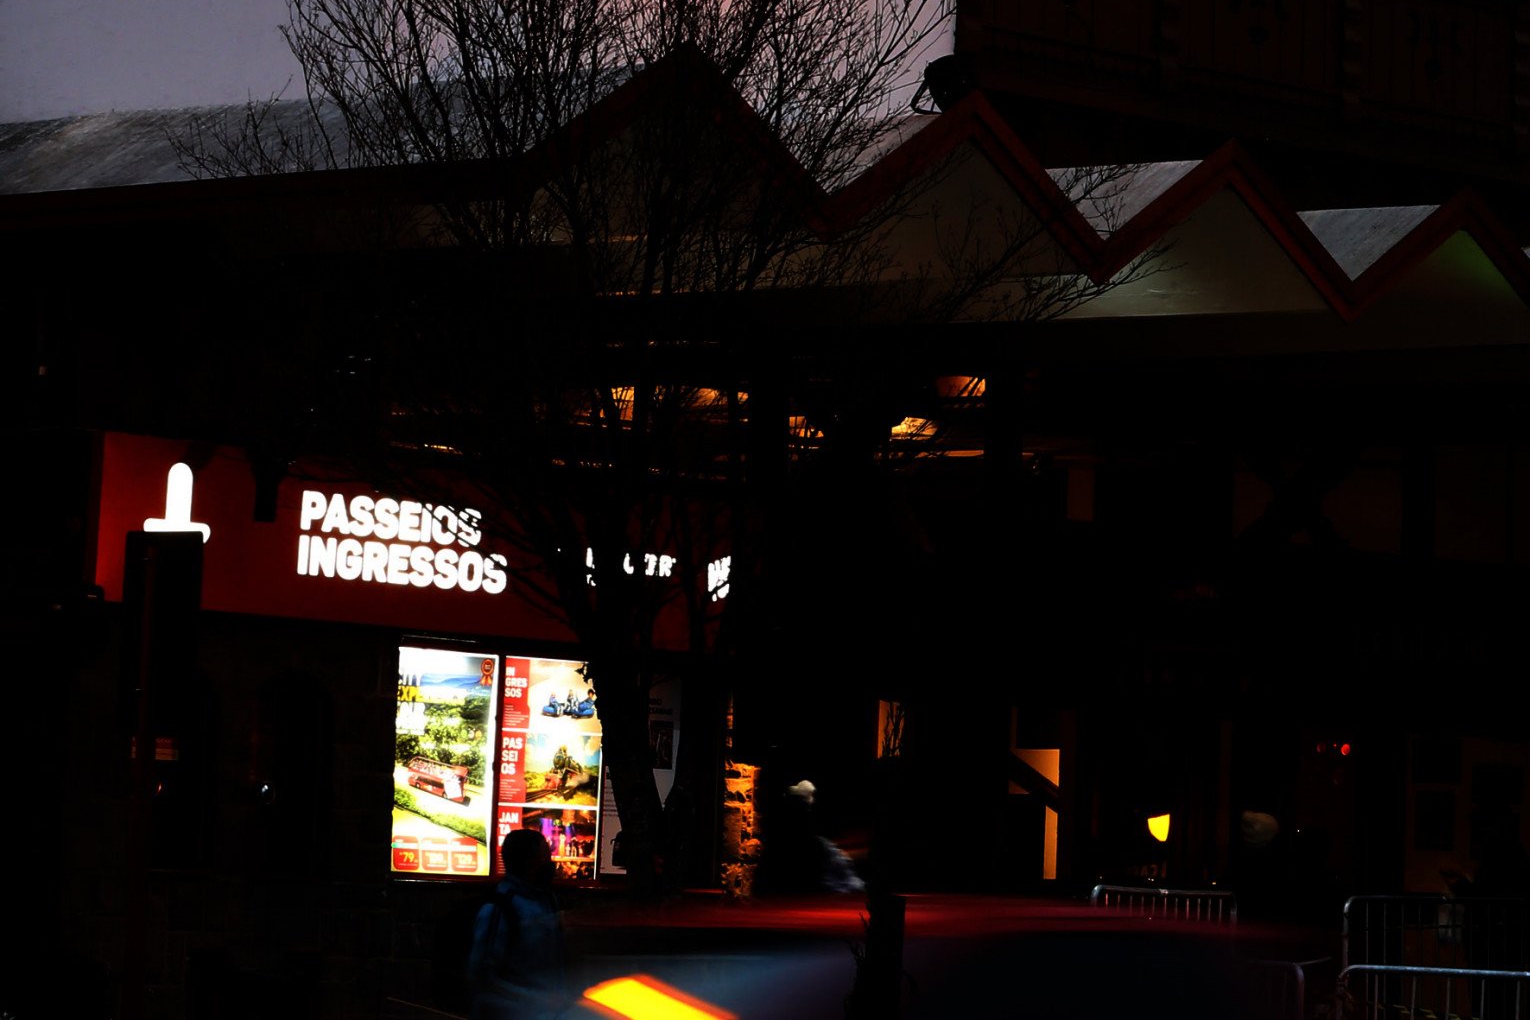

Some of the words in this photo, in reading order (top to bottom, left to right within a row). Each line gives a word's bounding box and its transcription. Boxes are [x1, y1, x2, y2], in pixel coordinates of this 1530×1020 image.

[300, 490, 482, 547] PASSEIOS
[297, 534, 508, 595] INGRESSOS
[504, 687, 522, 698] SOS
[502, 737, 523, 749] PAS
[501, 750, 519, 762] SEI
[500, 762, 516, 775] OS
[498, 812, 519, 823] JAN
[498, 823, 511, 835] TA
